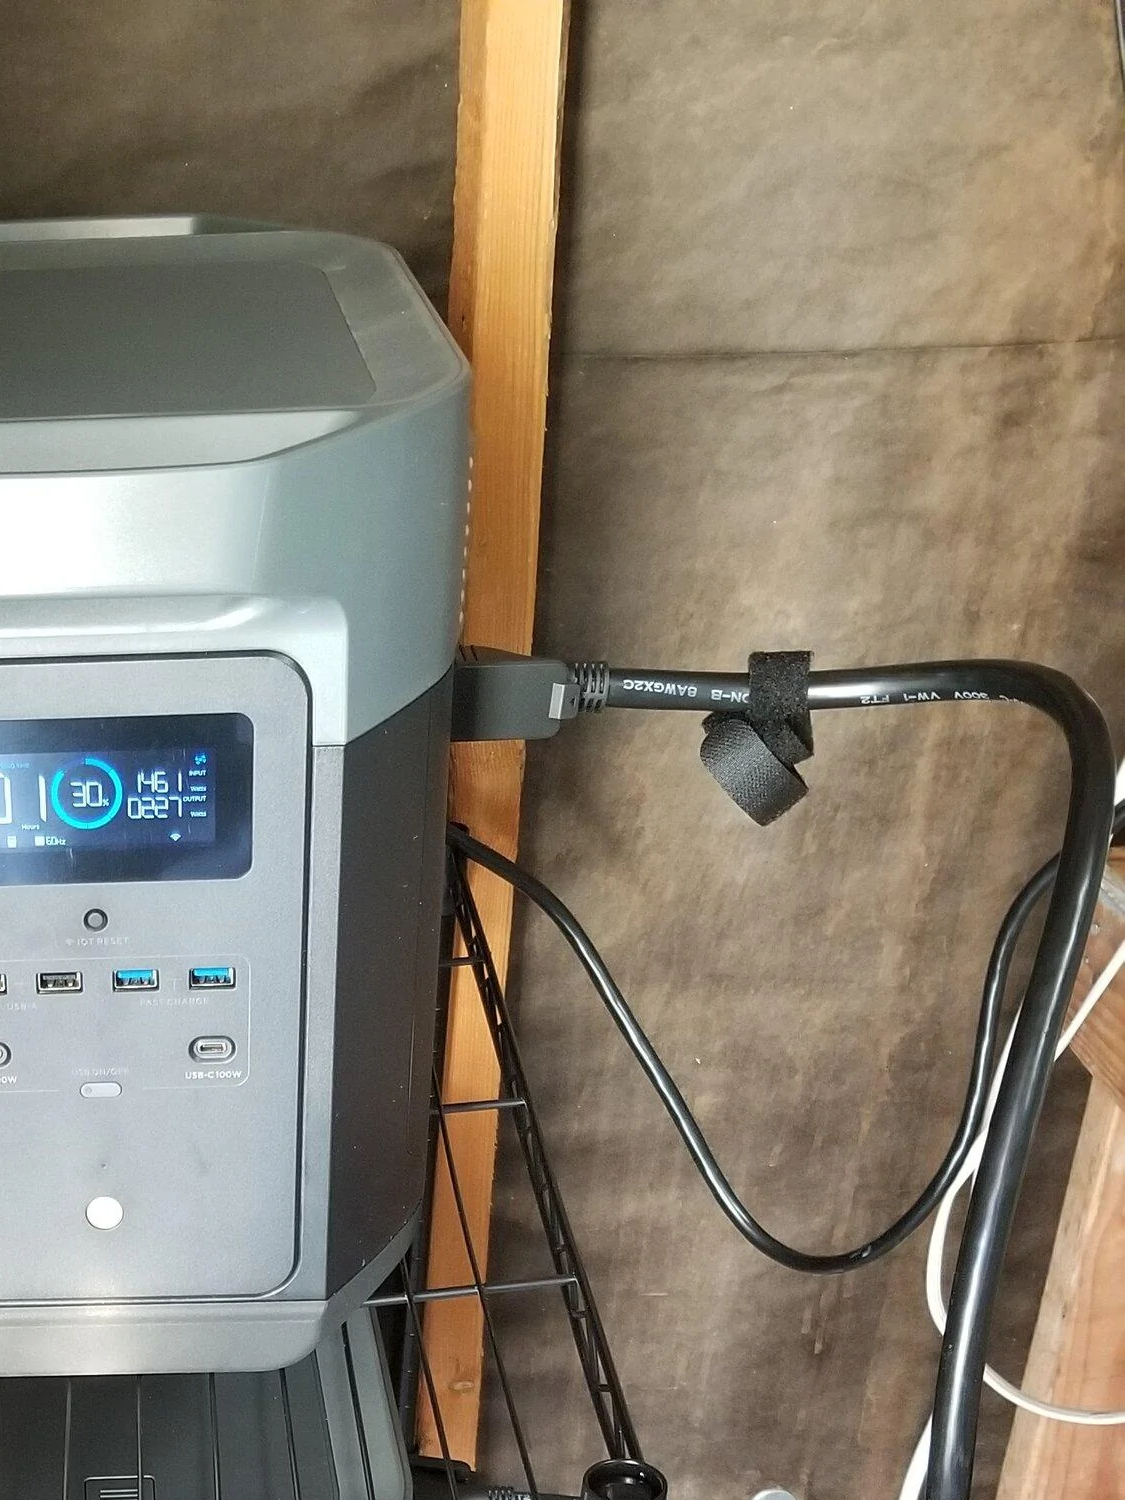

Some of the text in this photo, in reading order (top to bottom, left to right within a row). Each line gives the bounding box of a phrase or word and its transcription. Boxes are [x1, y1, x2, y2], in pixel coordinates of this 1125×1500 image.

[622, 678, 698, 698] 8AWGX2C
[902, 690, 941, 702] VW-1
[860, 694, 890, 705] FT2
[137, 769, 183, 794] 1461
[127, 795, 183, 819] 0227
